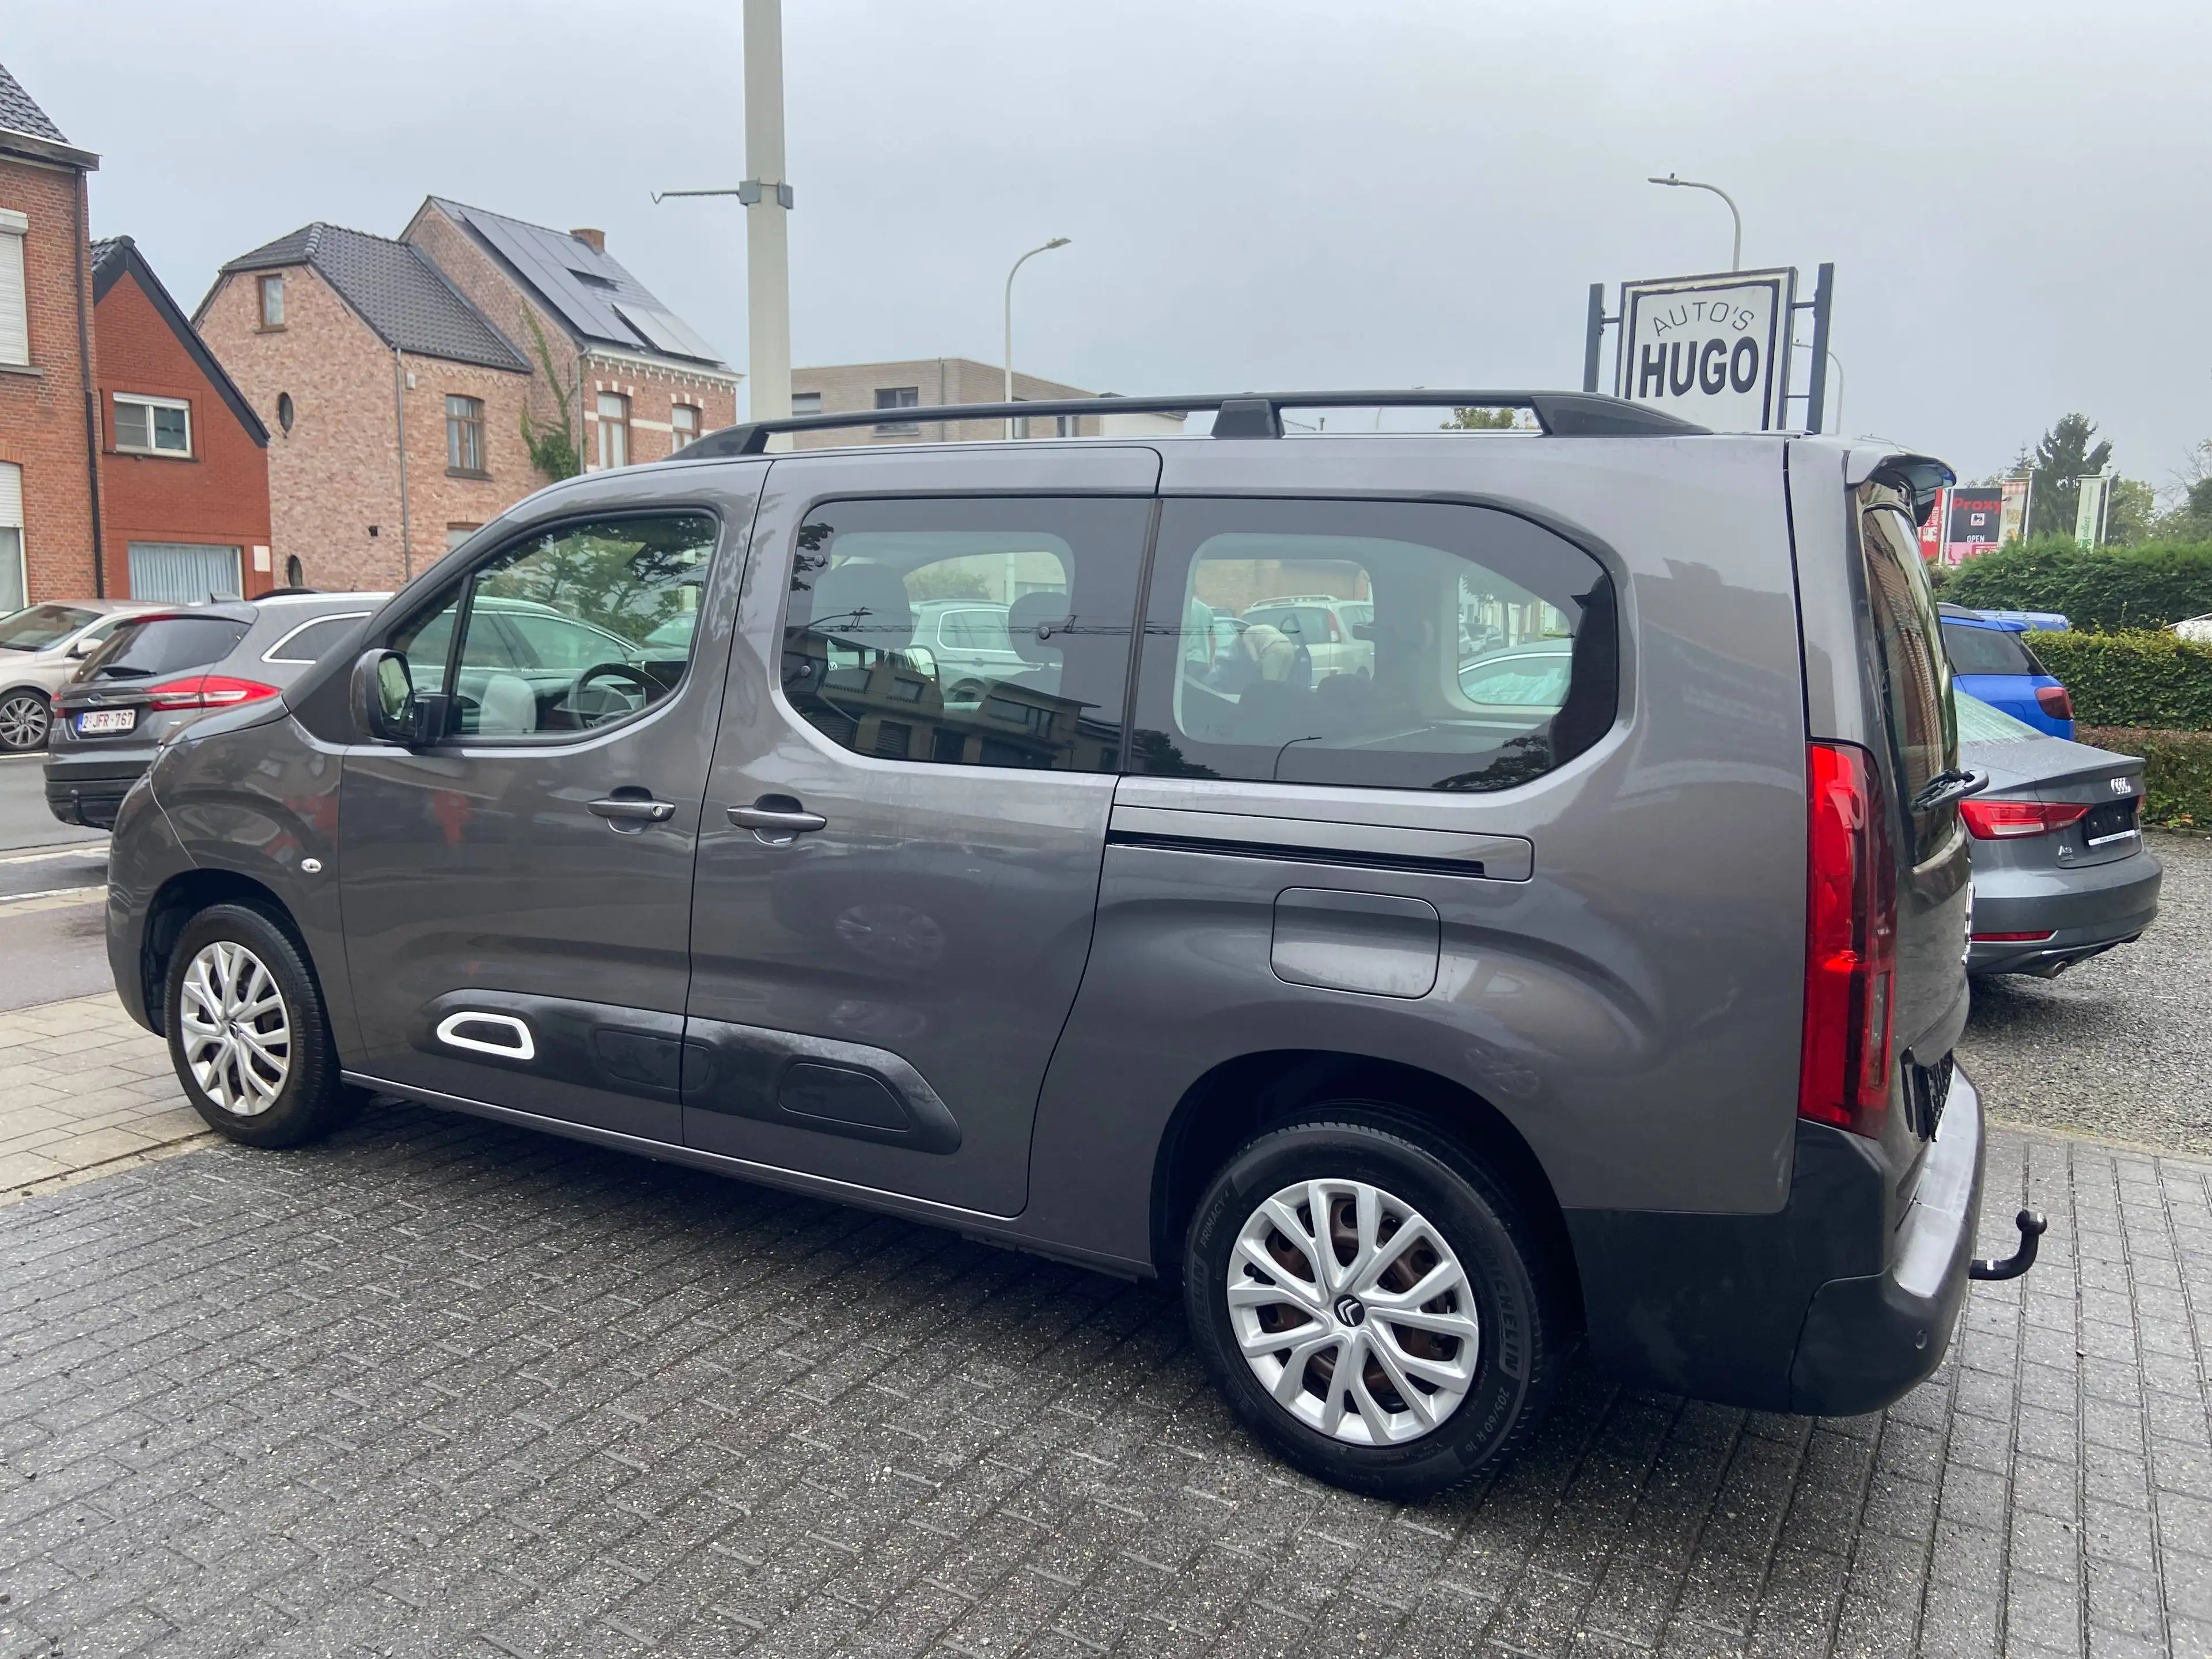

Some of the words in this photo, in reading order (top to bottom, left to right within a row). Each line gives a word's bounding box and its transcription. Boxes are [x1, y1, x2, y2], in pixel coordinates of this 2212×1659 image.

[1653, 301, 1755, 337] AUTO'S
[1639, 336, 1759, 397] HUGO
[1952, 497, 2001, 514] Proxy
[1966, 535, 1985, 543] OPEN
[1199, 1195, 1226, 1249] PRIMACY
[1478, 1246, 1520, 1372] MICHELIN
[1484, 1386, 1510, 1433] 205/60
[1465, 1440, 1479, 1453] 16
[1476, 1430, 1487, 1442] R
